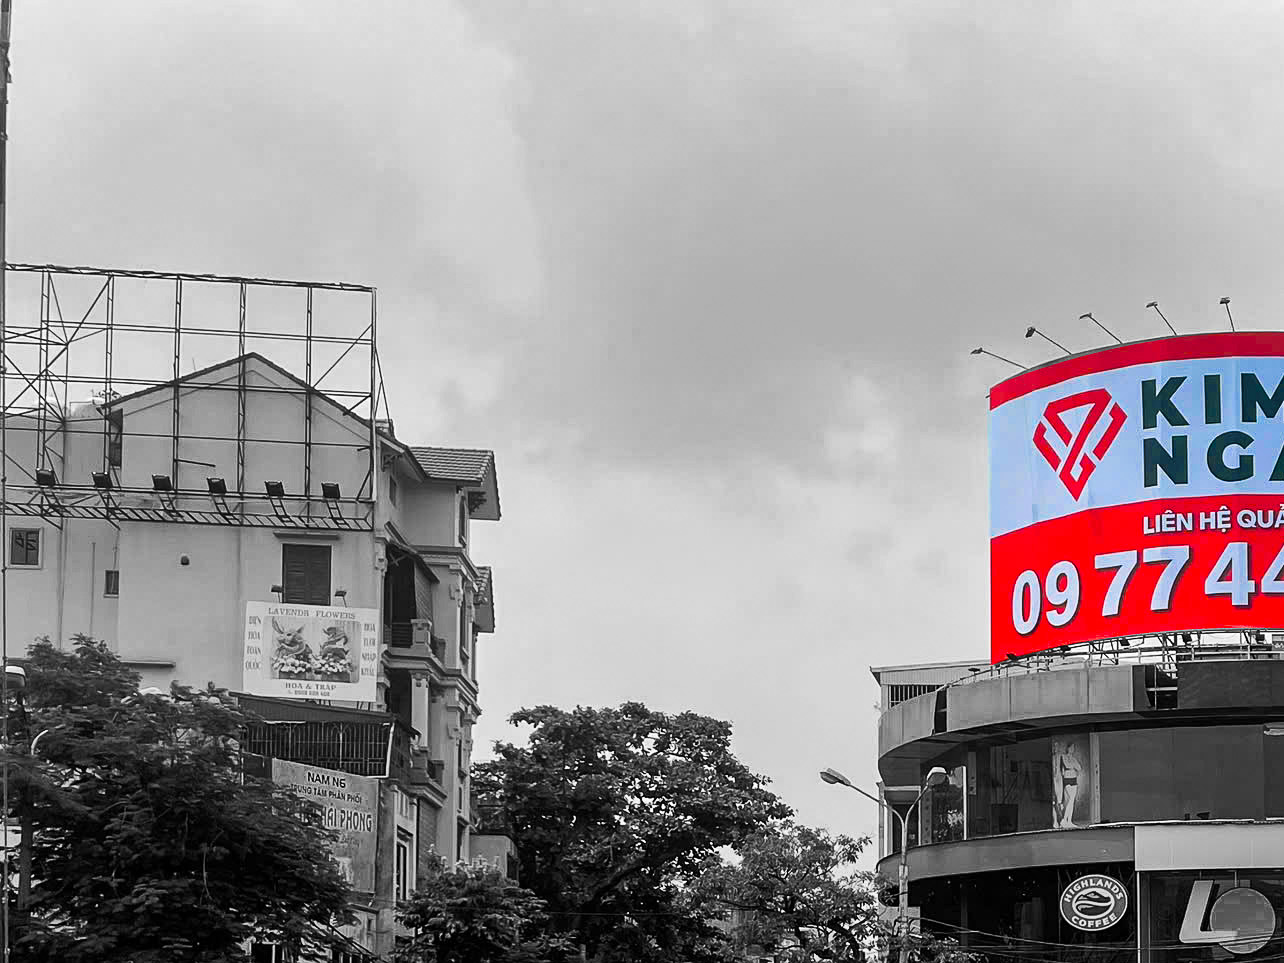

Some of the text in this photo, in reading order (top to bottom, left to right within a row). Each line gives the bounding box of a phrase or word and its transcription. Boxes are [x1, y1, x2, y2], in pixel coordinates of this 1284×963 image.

[1143, 510, 1193, 534] LIÊN
[1199, 506, 1232, 533] HỆ
[1012, 560, 1080, 635] 09
[1094, 545, 1190, 617] 77
[315, 610, 356, 620] FLOWERS
[285, 682, 303, 690] HOA
[307, 772, 330, 785] NAM
[1063, 878, 1124, 903] HIGHLANDS
[1071, 912, 1117, 928] COFFEE
